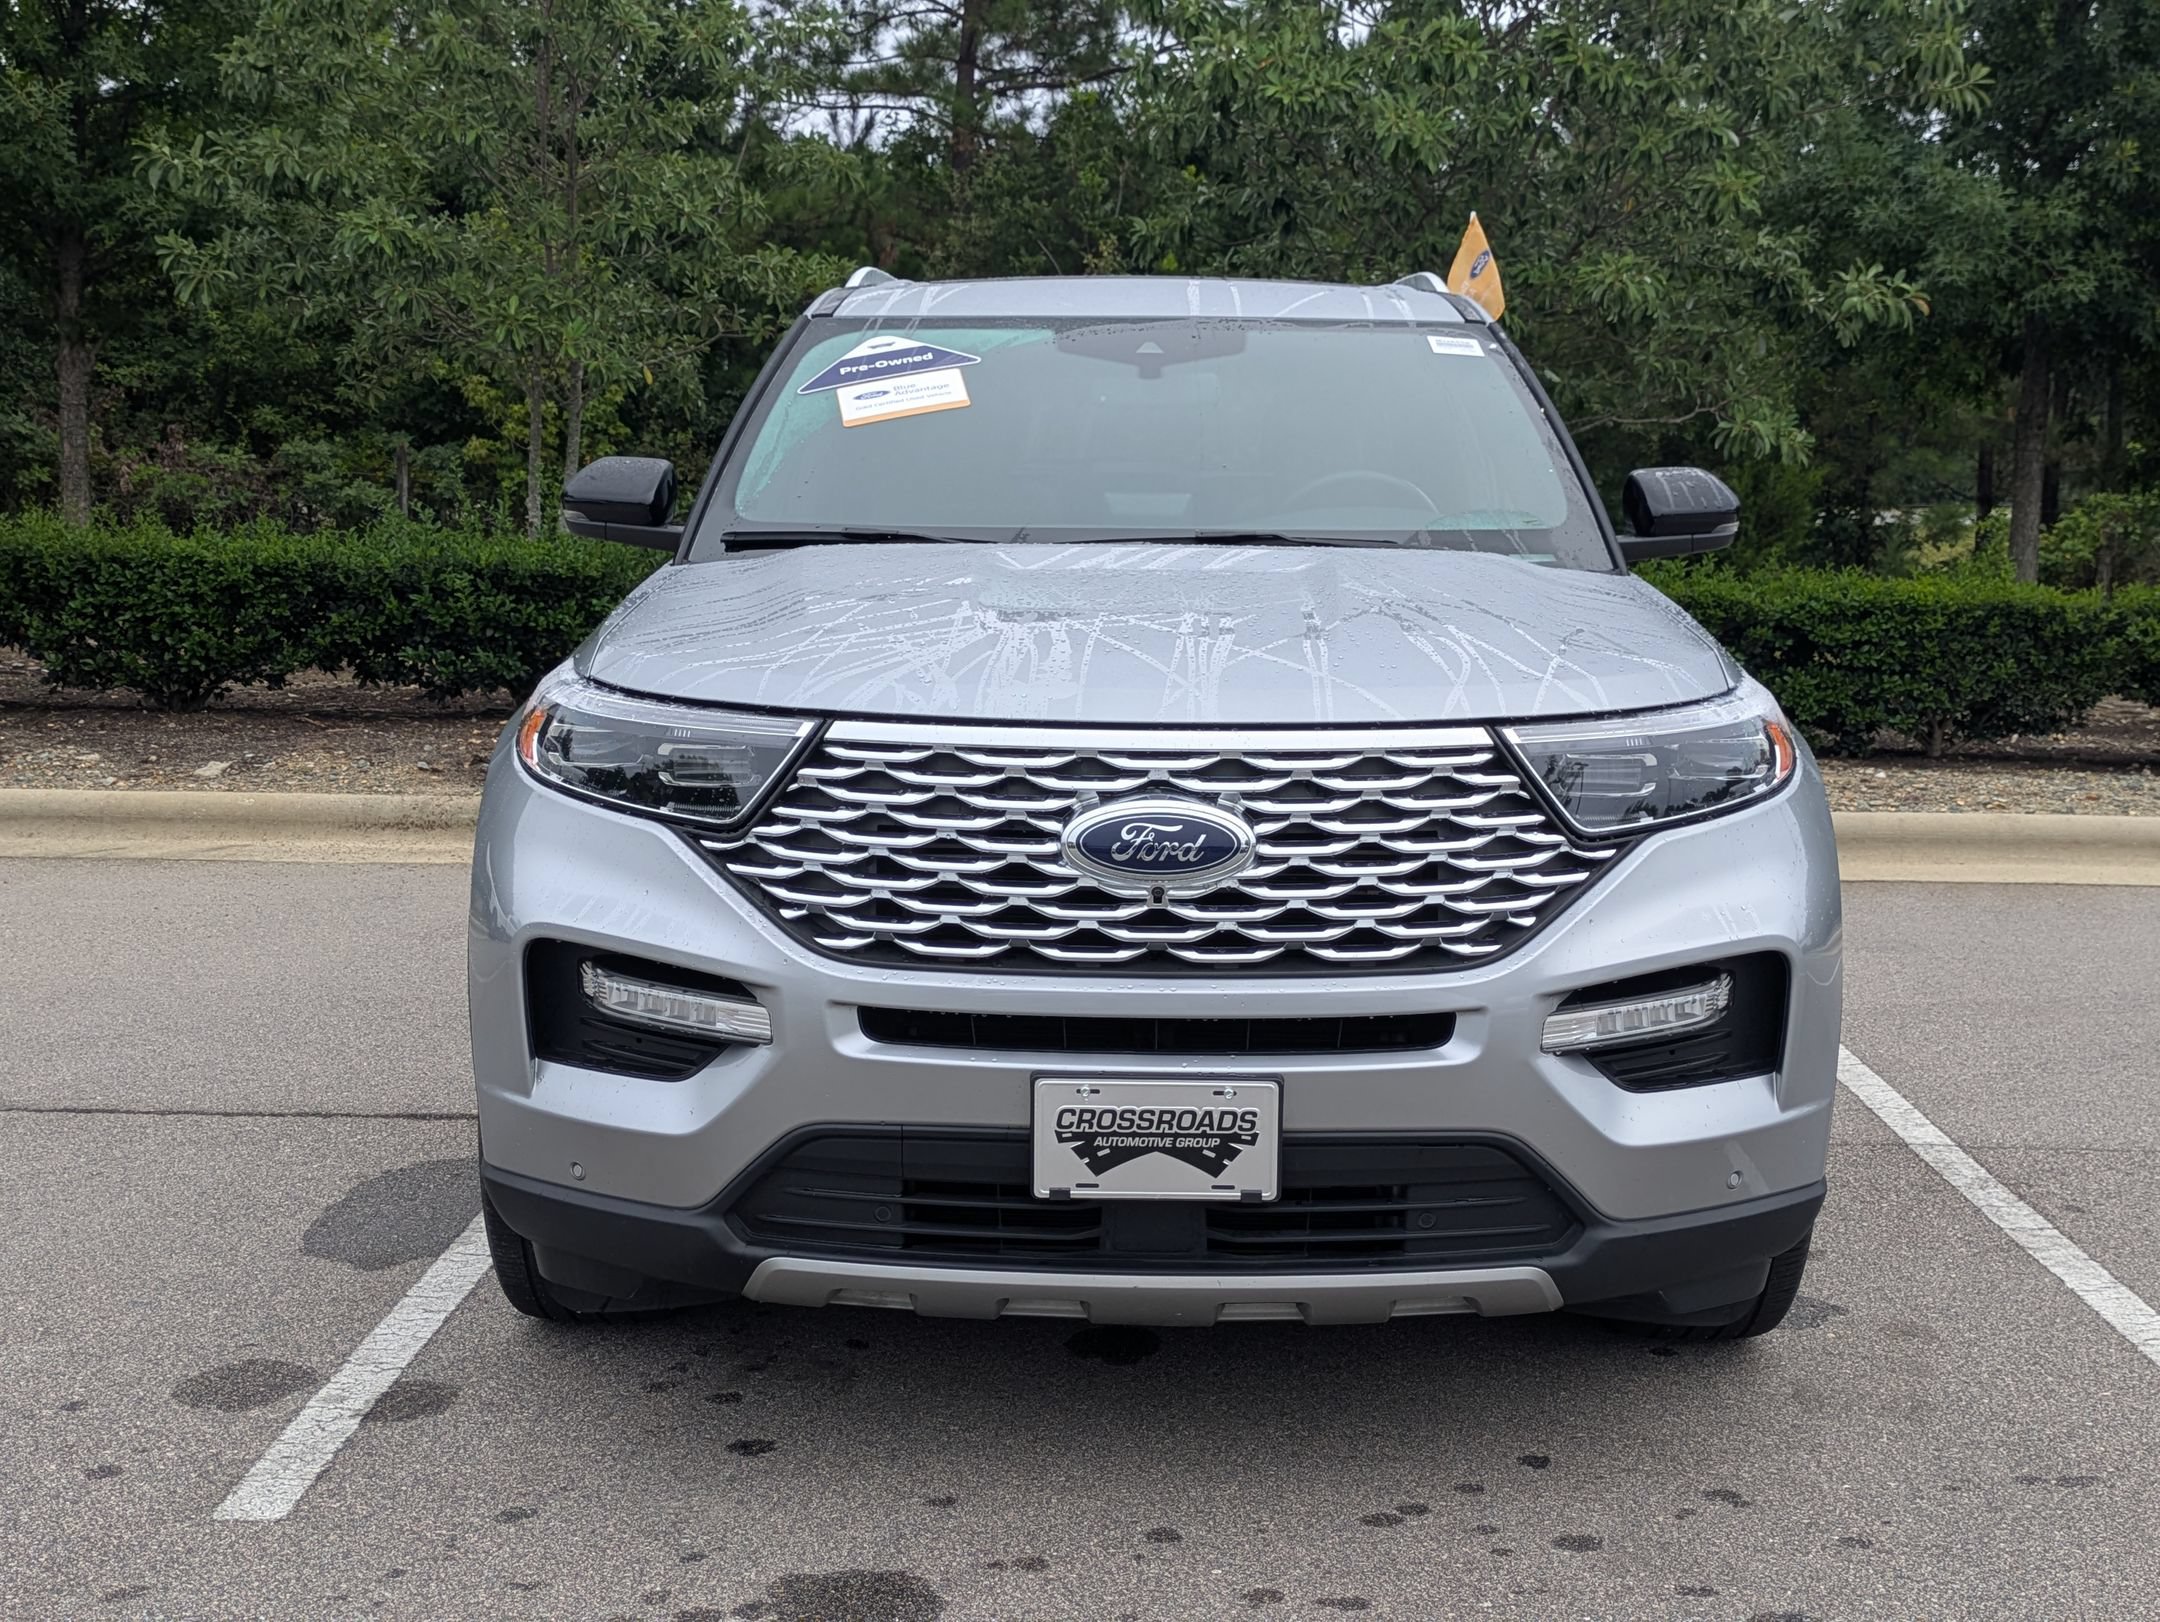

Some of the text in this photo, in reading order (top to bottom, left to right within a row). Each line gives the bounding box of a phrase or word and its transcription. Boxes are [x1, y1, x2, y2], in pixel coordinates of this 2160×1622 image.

[839, 352, 933, 375] Pre-Owned
[893, 383, 916, 391] Blue
[894, 383, 950, 396] Advantage
[1111, 822, 1207, 862] Ford
[1055, 1108, 1258, 1133] CROSSROADS
[1093, 1135, 1221, 1149] AUTOMOTIVE GROUP
